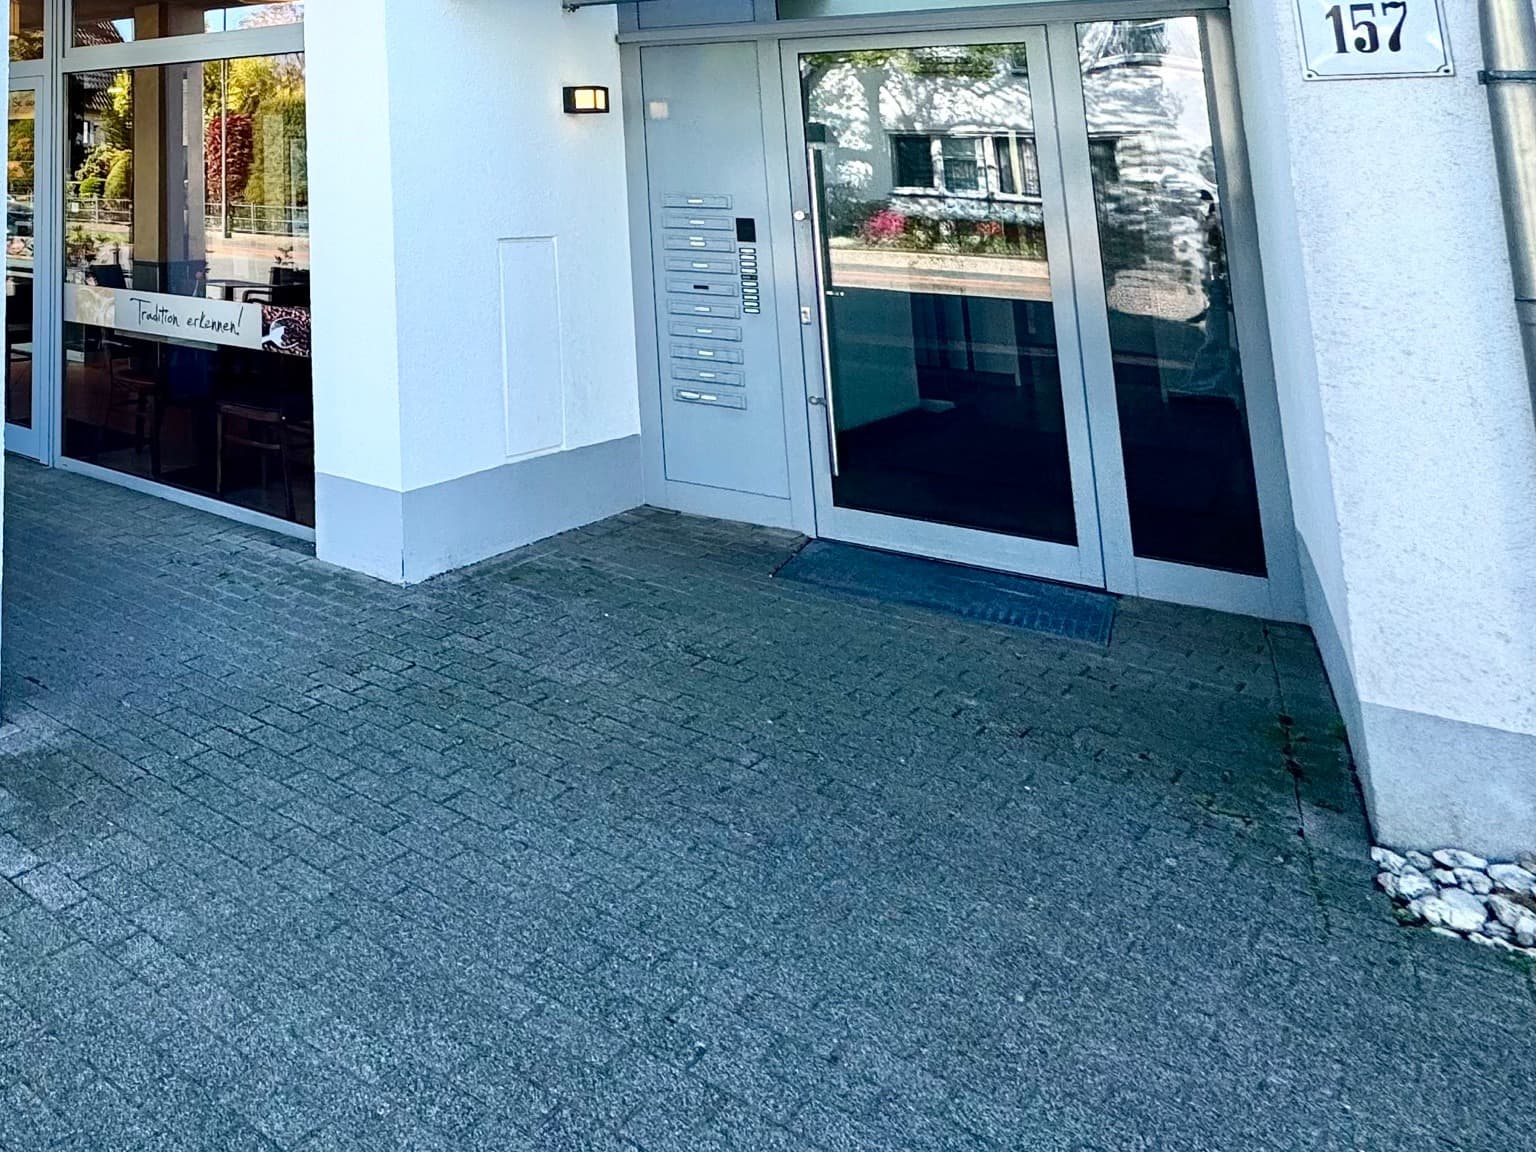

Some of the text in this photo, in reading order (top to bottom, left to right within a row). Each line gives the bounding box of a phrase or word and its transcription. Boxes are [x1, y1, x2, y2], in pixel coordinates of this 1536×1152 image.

[1325, 1, 1407, 54] 157
[129, 297, 244, 336] Tradition erkennen!
